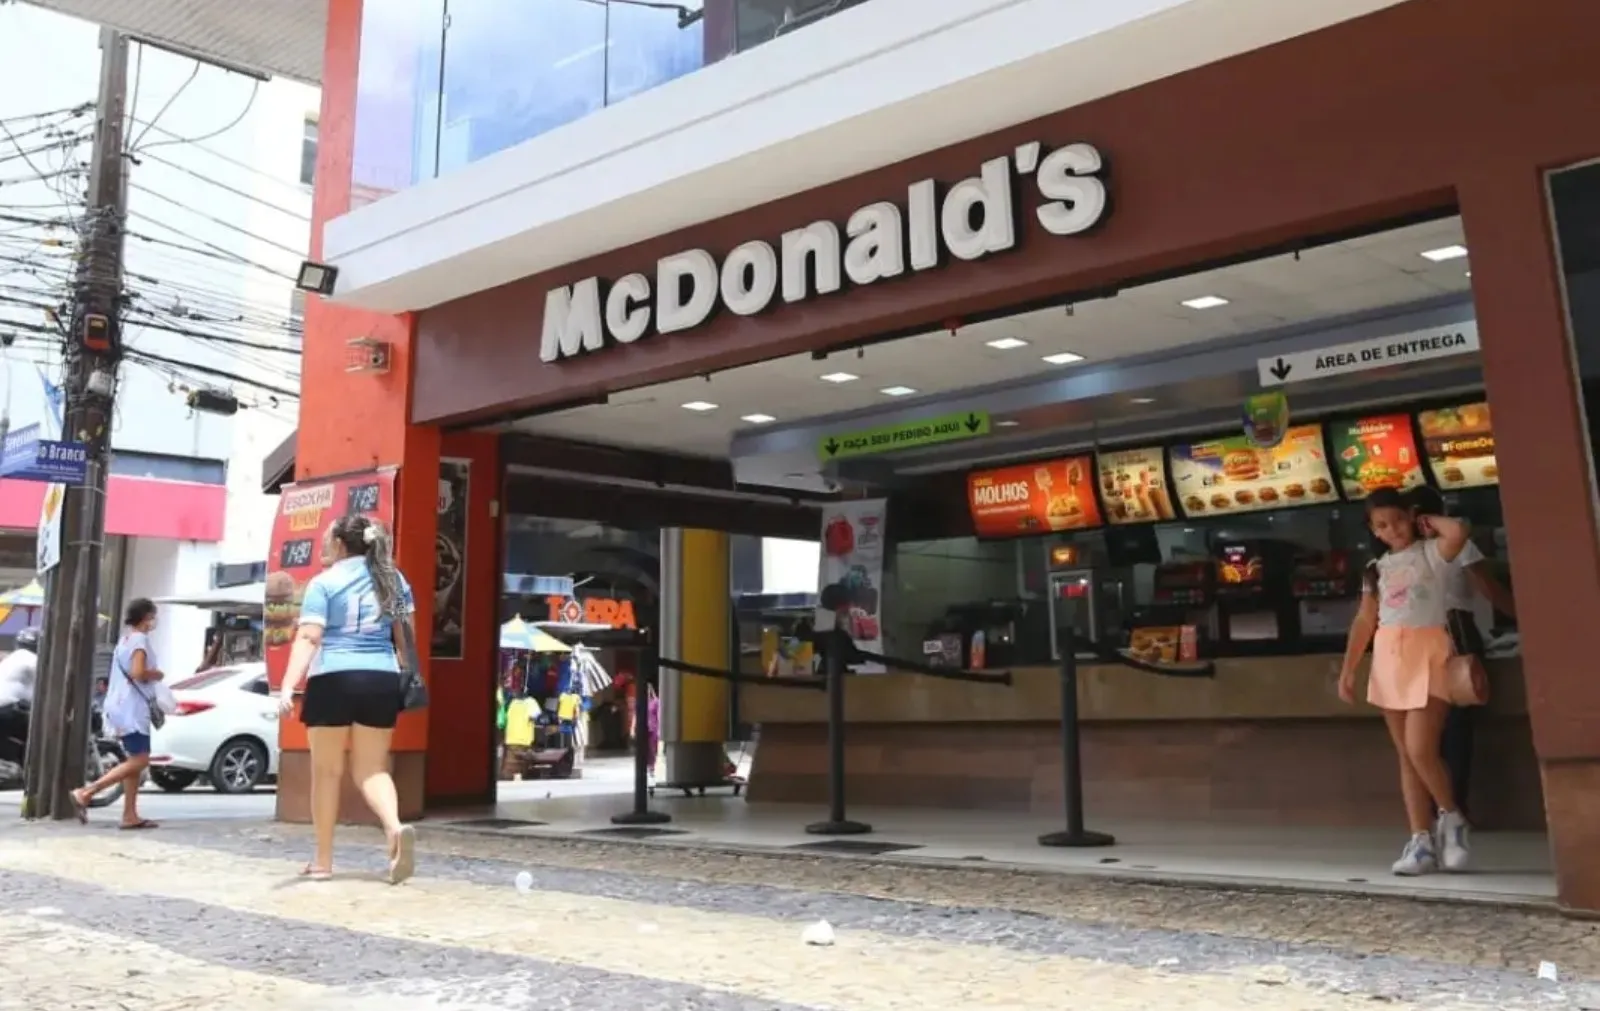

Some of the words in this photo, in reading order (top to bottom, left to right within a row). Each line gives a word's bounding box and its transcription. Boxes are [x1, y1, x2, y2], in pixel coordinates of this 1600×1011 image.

[539, 141, 1107, 363] McDonald's
[1315, 352, 1357, 370] ÁREA
[1362, 347, 1382, 362] DE
[1388, 332, 1466, 358] ENTREGA
[871, 433, 891, 446] SEU
[49, 444, 86, 462] Branco
[974, 480, 1029, 506] MOLHOS
